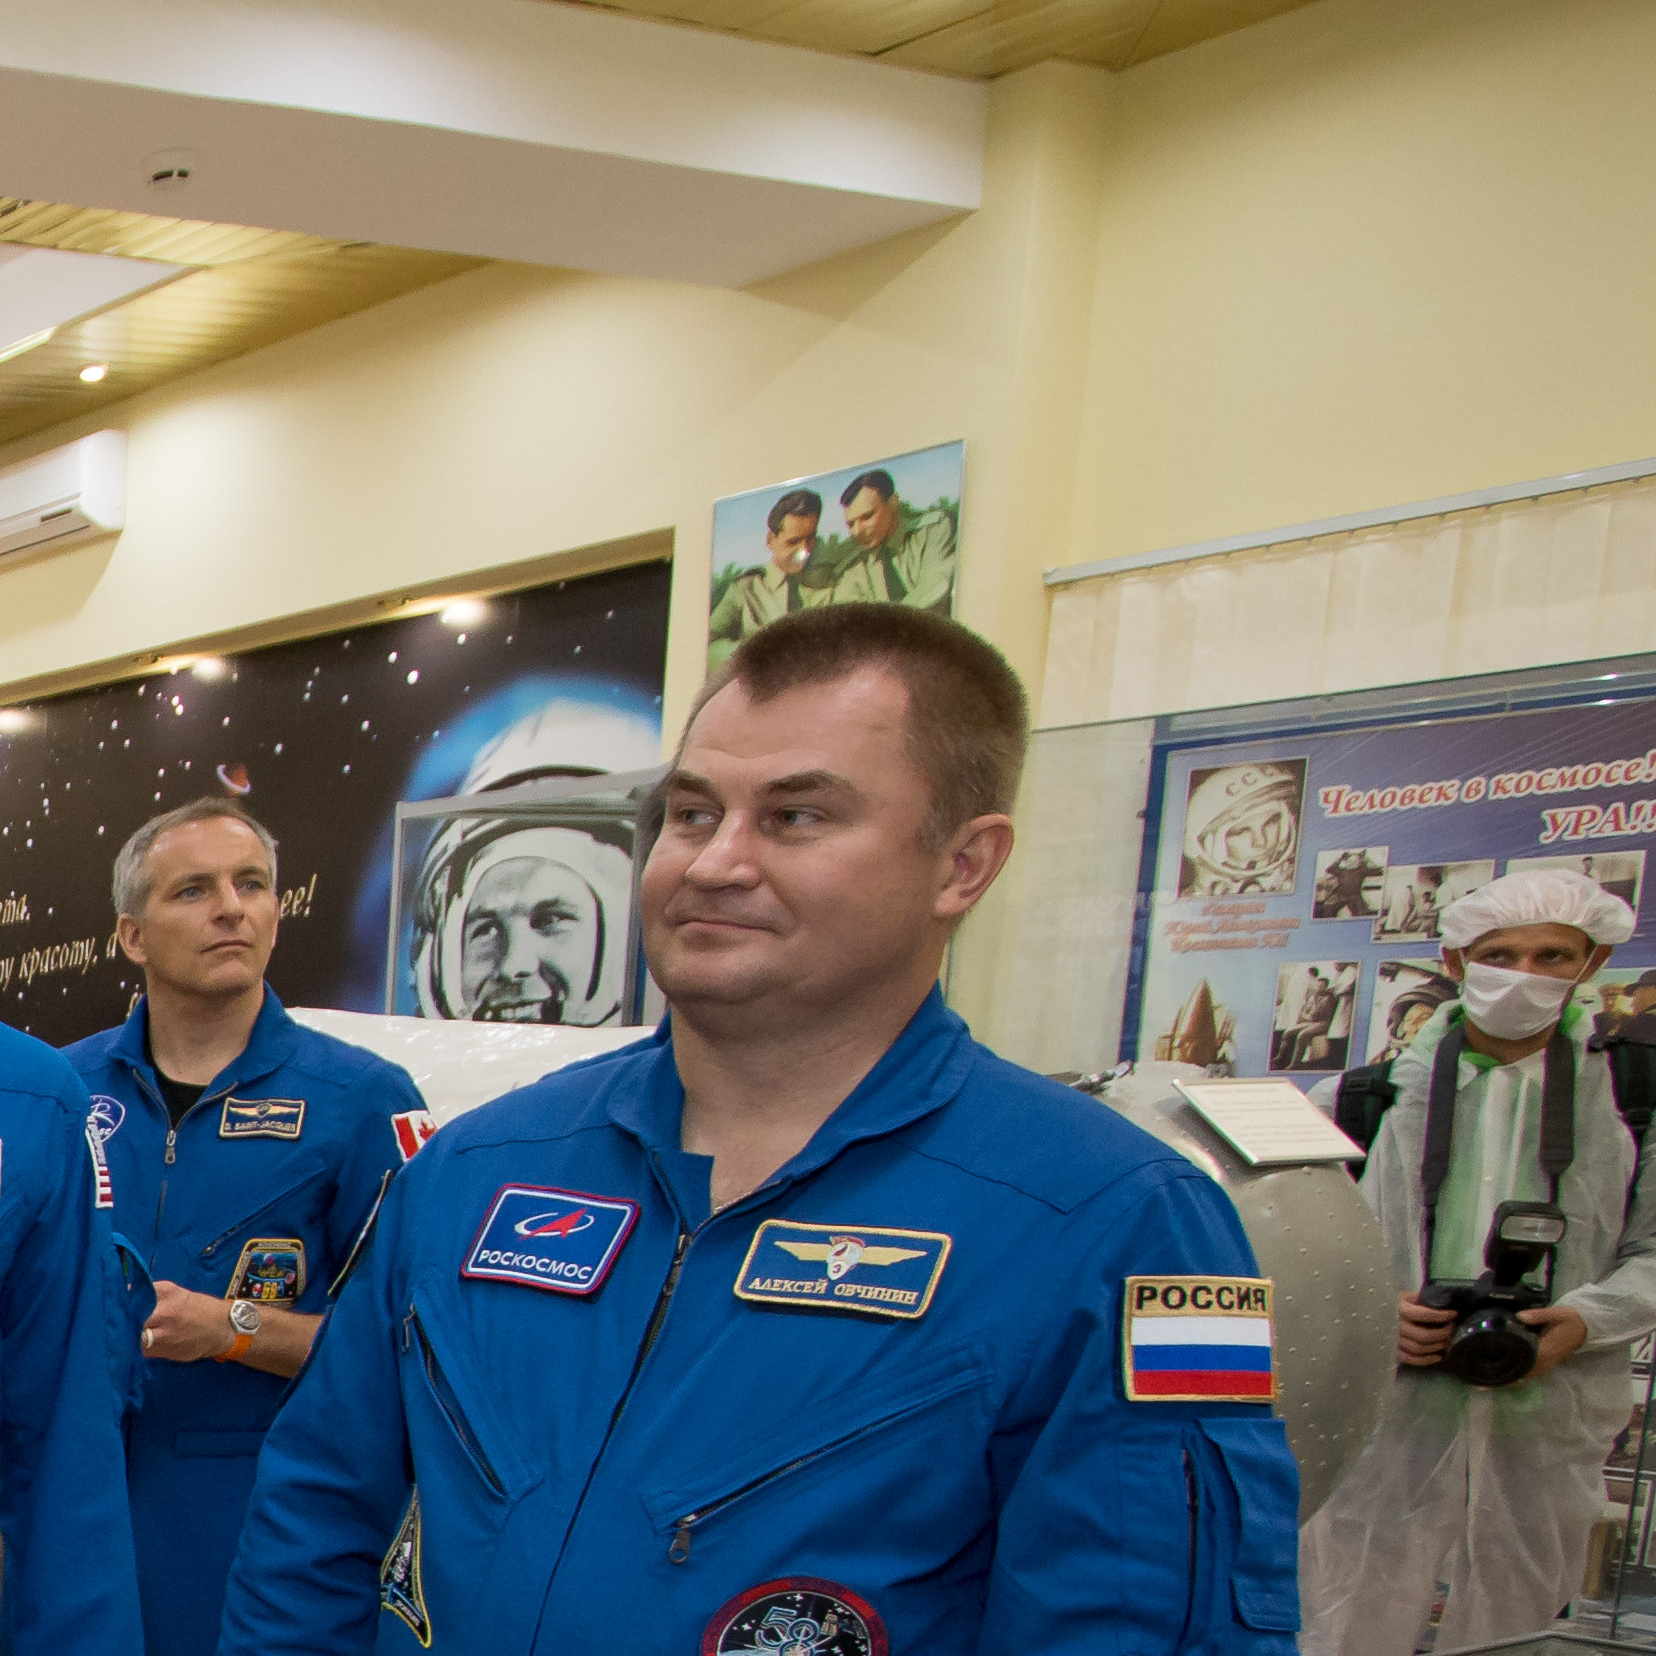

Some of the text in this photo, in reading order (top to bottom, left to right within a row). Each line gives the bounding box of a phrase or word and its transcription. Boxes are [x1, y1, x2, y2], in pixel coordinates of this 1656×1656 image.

[1320, 779, 1459, 818] Человек
[1461, 776, 1487, 803] в
[477, 1249, 593, 1280] РОСКОСМОС
[747, 1277, 920, 1306] АЛЕКСЕЙ ОВЧИНИН
[1135, 1285, 1268, 1312] РОССИЯ
